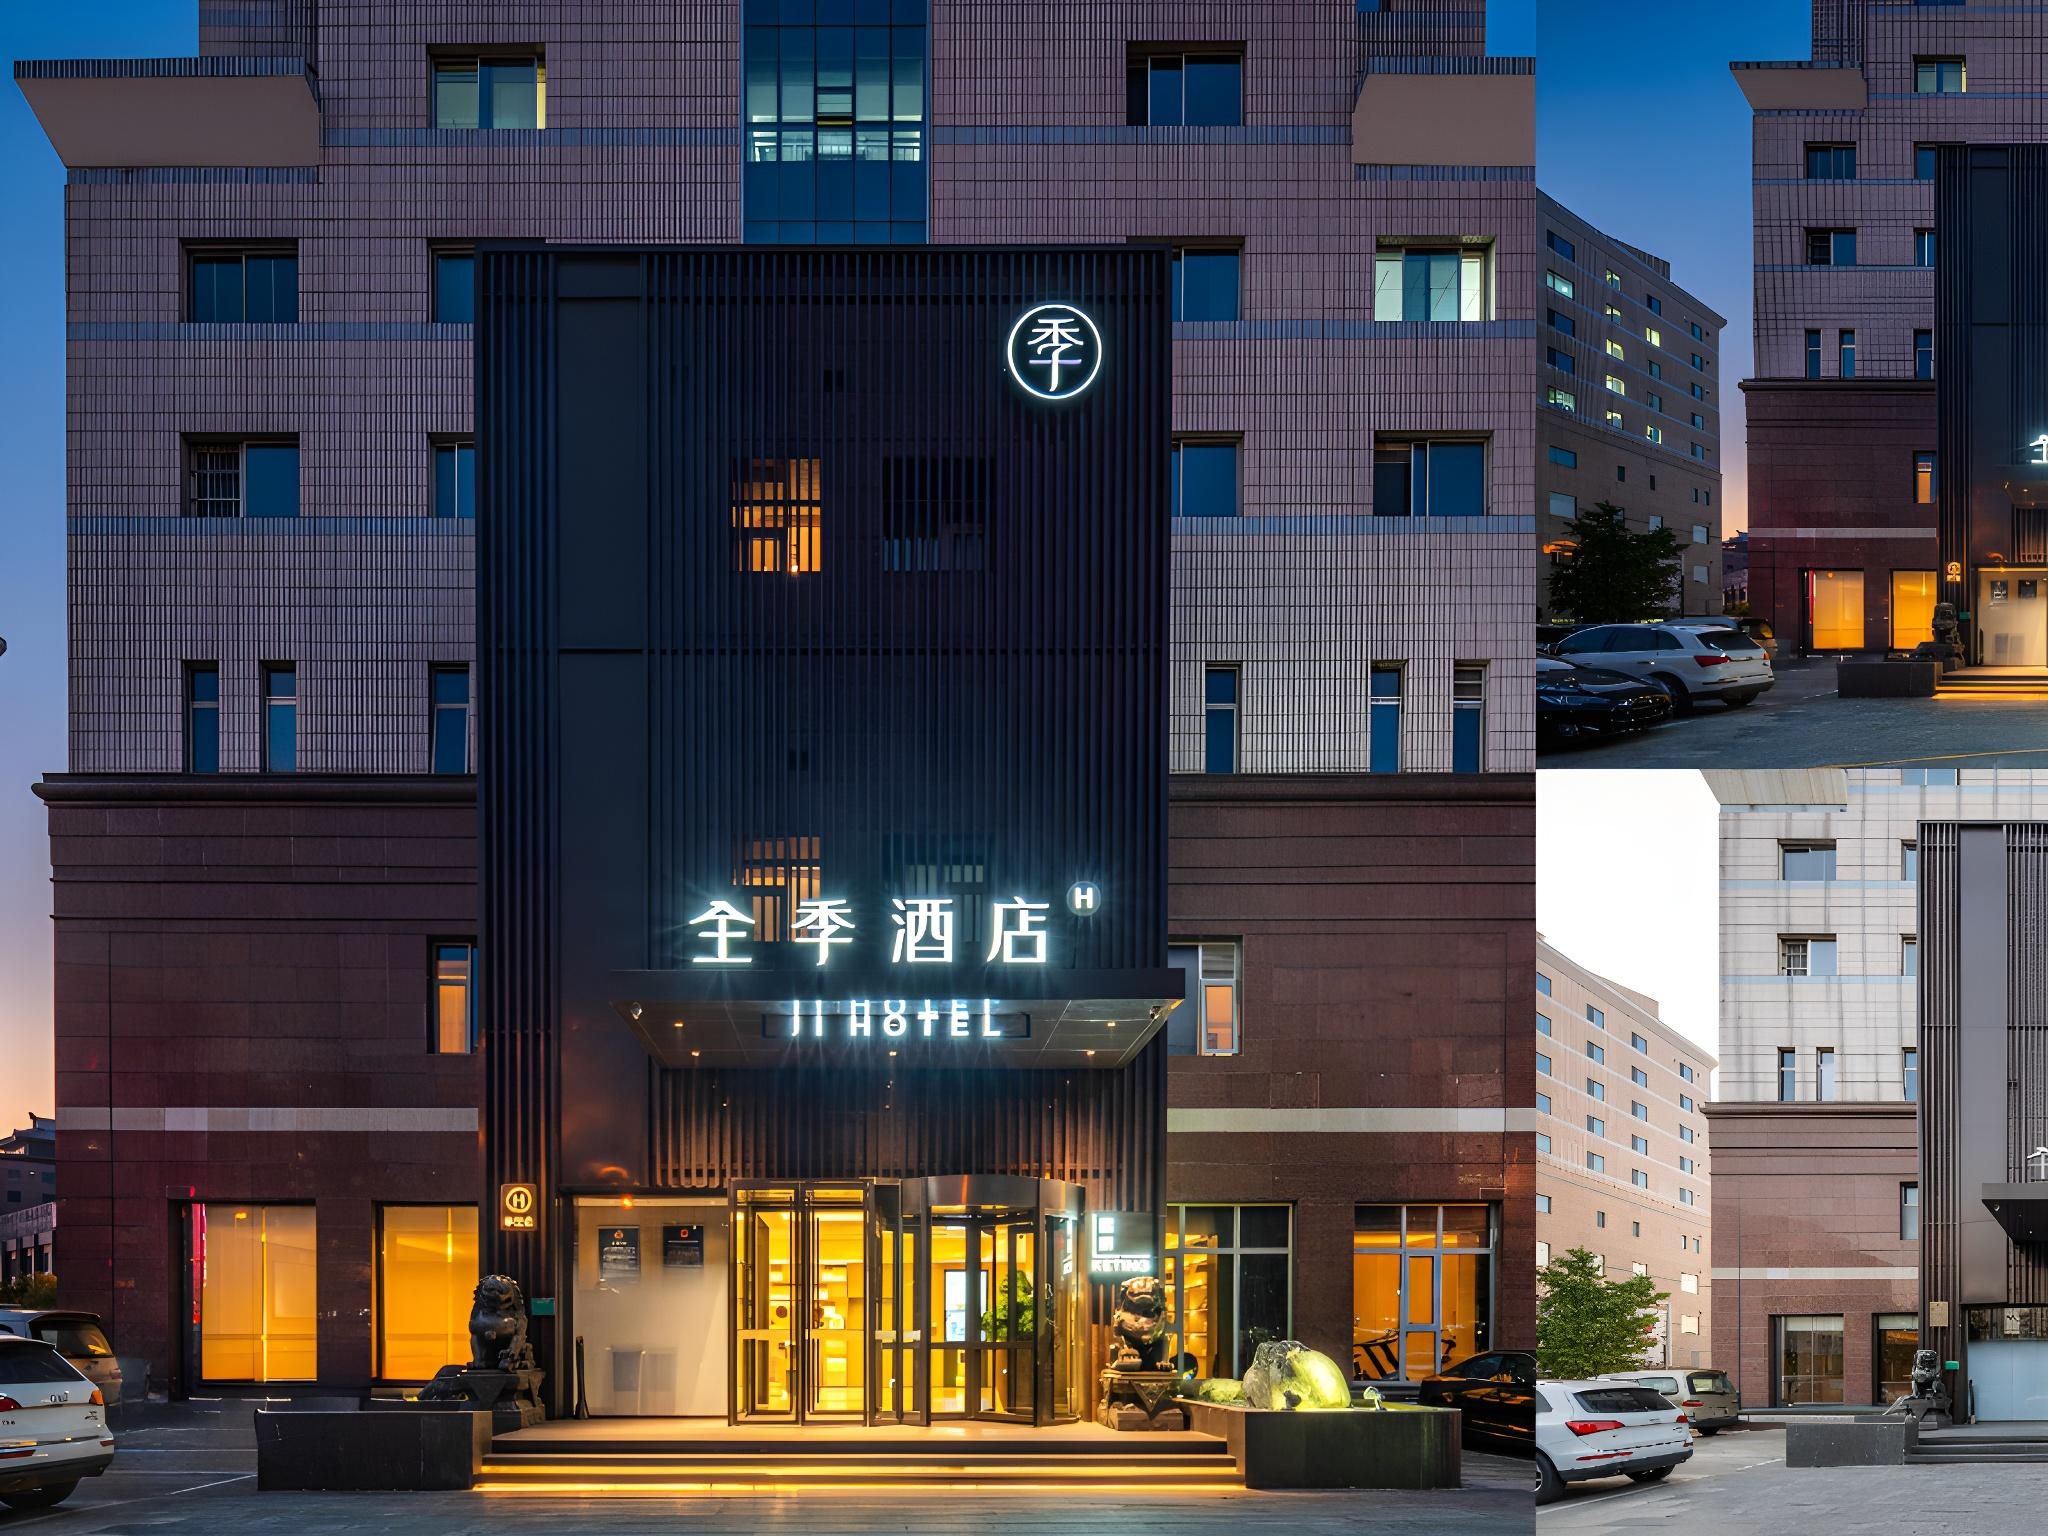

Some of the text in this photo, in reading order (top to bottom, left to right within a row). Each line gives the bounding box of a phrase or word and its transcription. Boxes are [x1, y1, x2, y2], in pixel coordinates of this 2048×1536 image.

[1025, 317, 1086, 393] 季
[689, 896, 1050, 966] 全季酒店
[849, 1003, 1001, 1037] HOTEL
